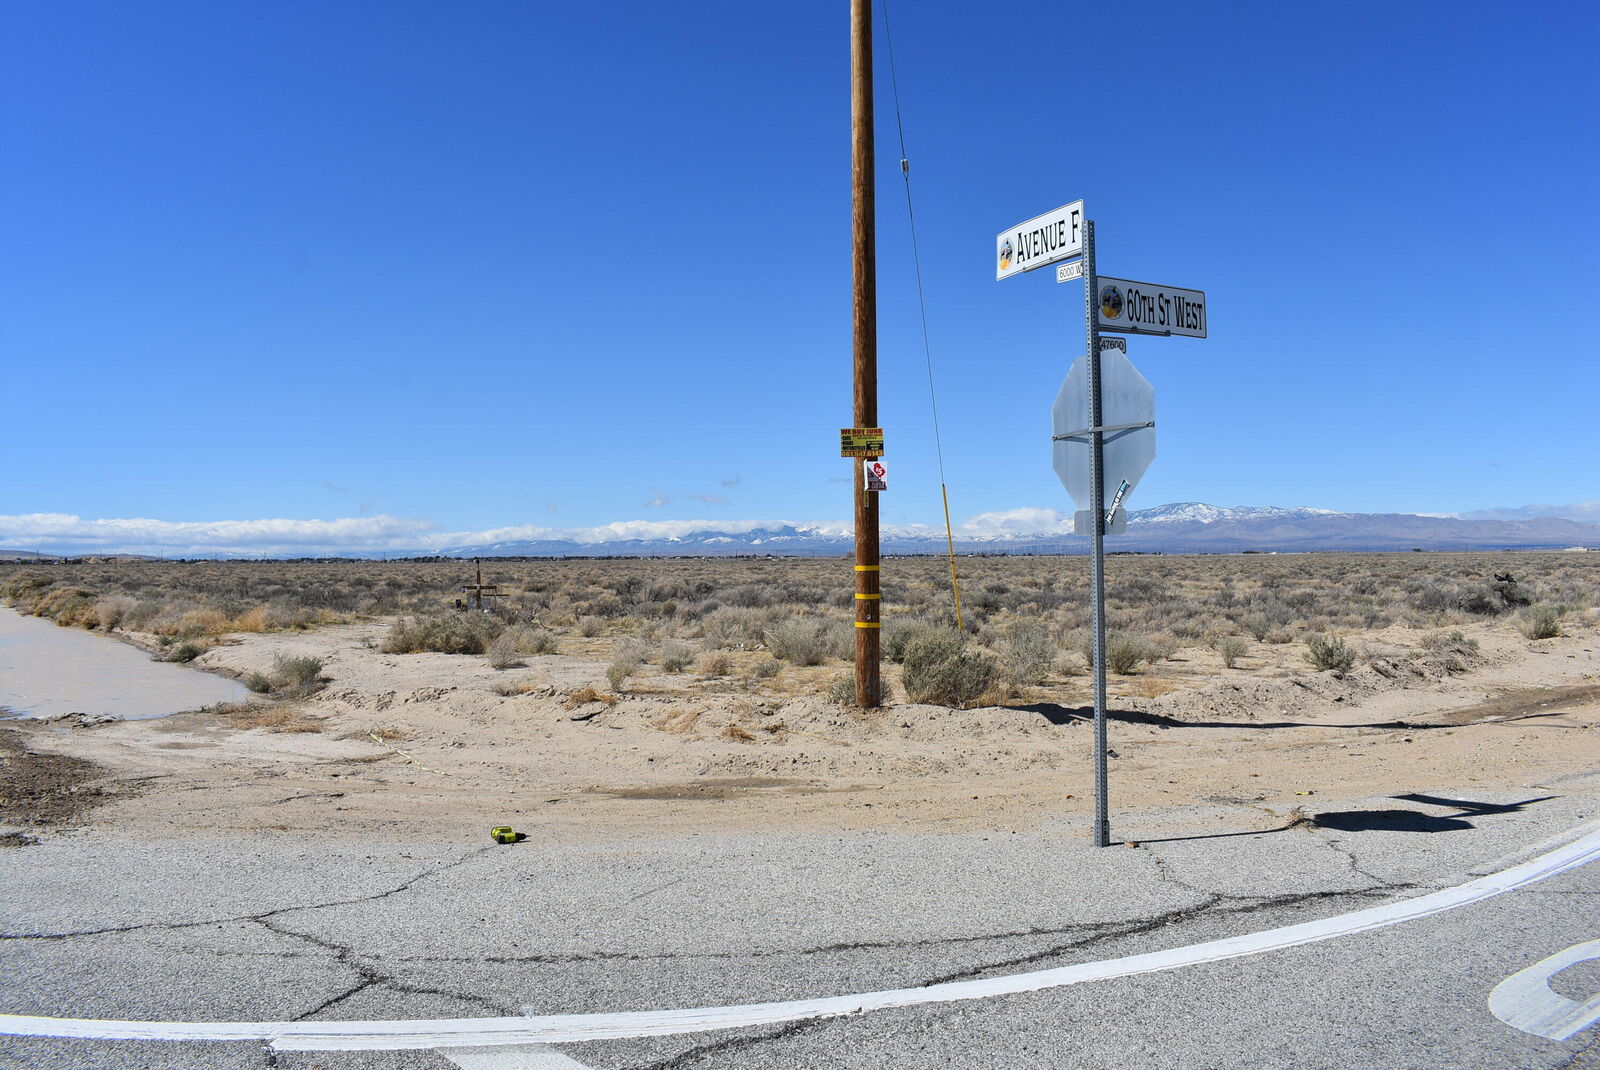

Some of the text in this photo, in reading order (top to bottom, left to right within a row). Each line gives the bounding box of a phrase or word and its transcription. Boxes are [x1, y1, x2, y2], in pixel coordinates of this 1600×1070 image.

[1017, 209, 1080, 264] AVENUE F
[1060, 266, 1075, 279] 6000
[1127, 288, 1203, 330] 60TH ST WEST
[1101, 340, 1124, 350] 47600
